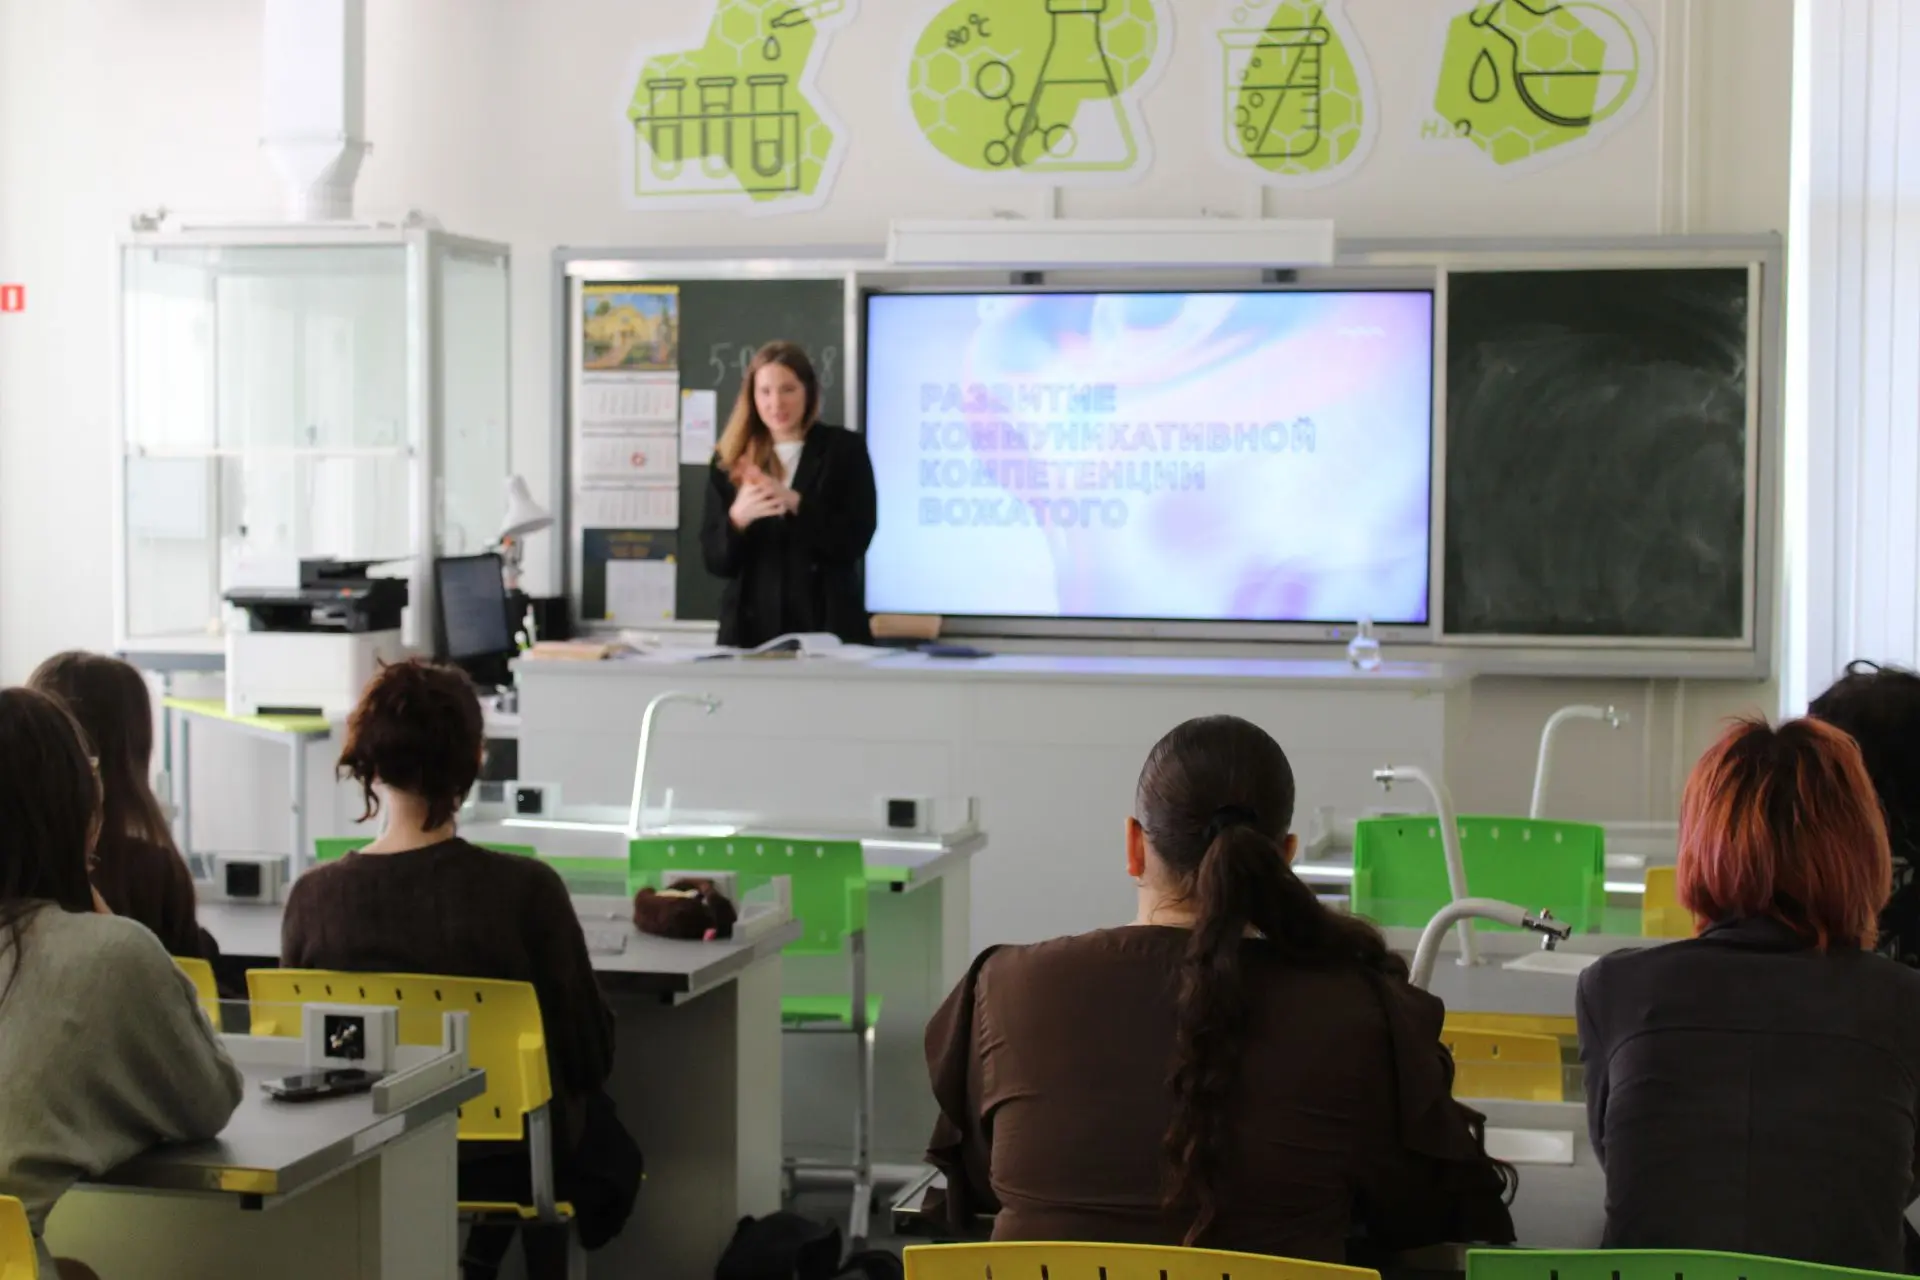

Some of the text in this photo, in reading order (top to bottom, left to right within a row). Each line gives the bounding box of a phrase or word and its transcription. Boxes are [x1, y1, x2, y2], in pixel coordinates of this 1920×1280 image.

[919, 383, 1117, 414] РАЗВИТИЕ
[919, 416, 1317, 453] КОММУНИКАТИВНОЙ
[919, 459, 1207, 494] КОМПЕТЕНЦИИ
[919, 497, 1129, 527] ВОЖАТОГО
